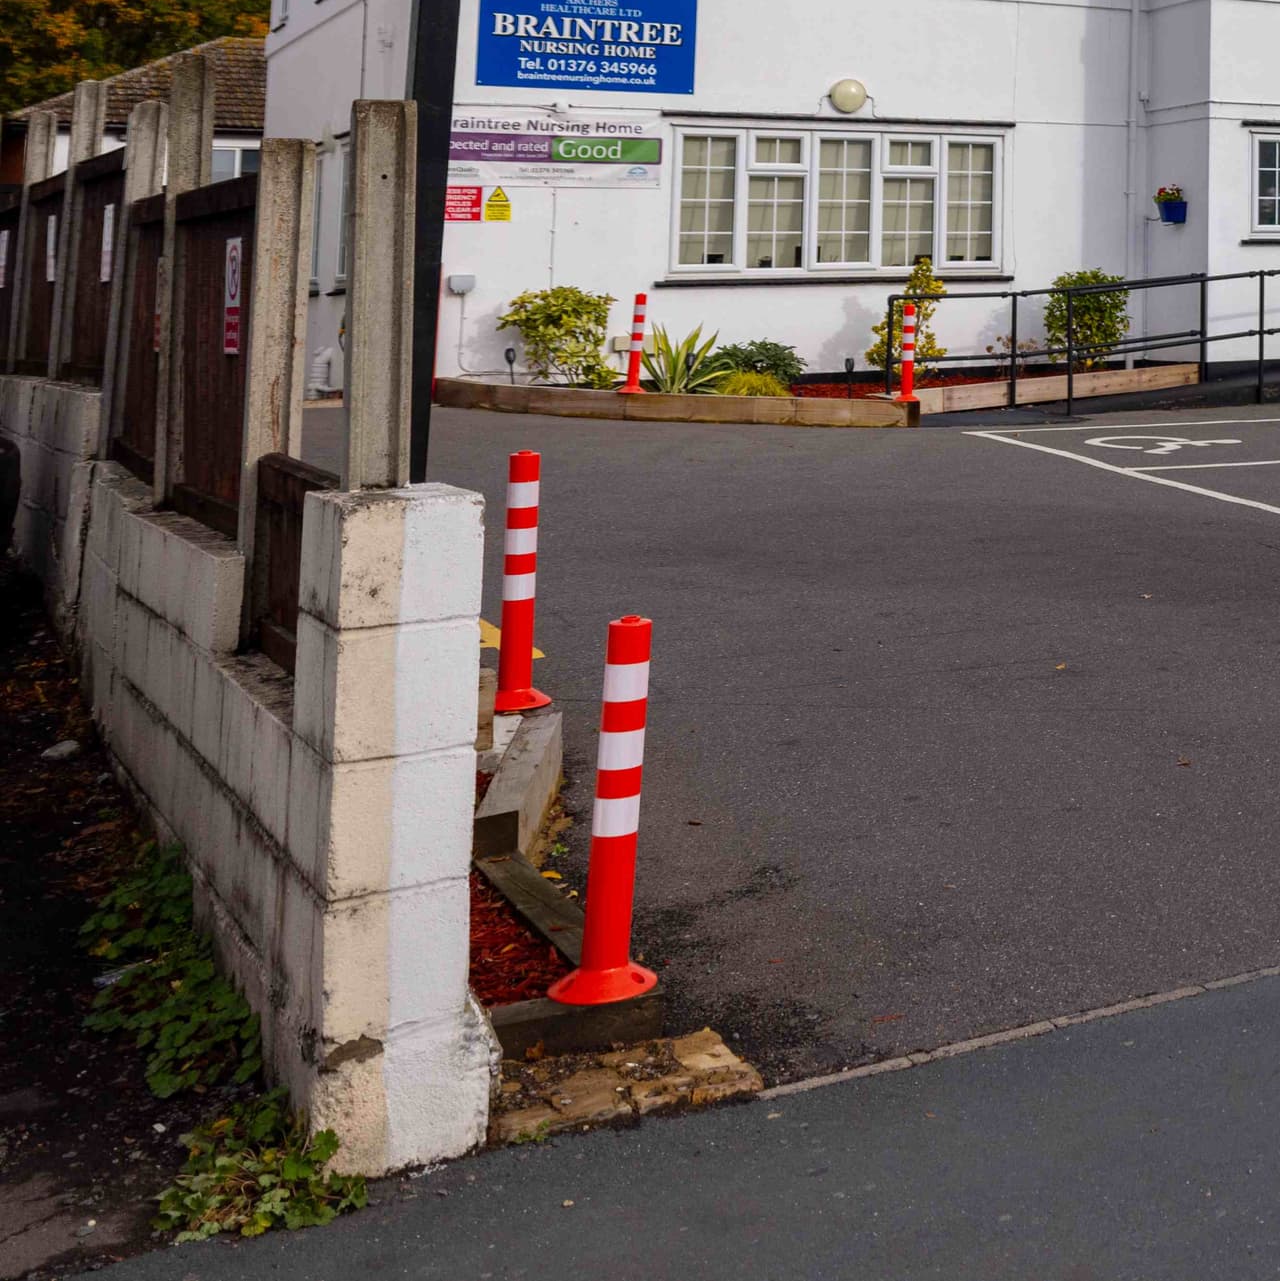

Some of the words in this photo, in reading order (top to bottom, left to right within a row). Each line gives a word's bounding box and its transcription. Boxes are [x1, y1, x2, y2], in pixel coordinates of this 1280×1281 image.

[540, 3, 617, 17] HEALTHCARE
[619, 9, 643, 18] LTD
[492, 12, 683, 46] BRAINTREE
[520, 39, 600, 57] NURSING
[604, 45, 657, 59] HOME
[518, 57, 544, 70] Tel.
[547, 58, 597, 72] 01376
[600, 61, 658, 75] 345966
[517, 70, 657, 85] braintreenursinghome.co.uk
[453, 116, 521, 131] raintree
[526, 119, 591, 135] Nursing
[595, 120, 644, 134] Home
[449, 140, 489, 151] ected
[491, 141, 515, 151] and
[517, 141, 549, 152] rated
[558, 139, 623, 160] Good
